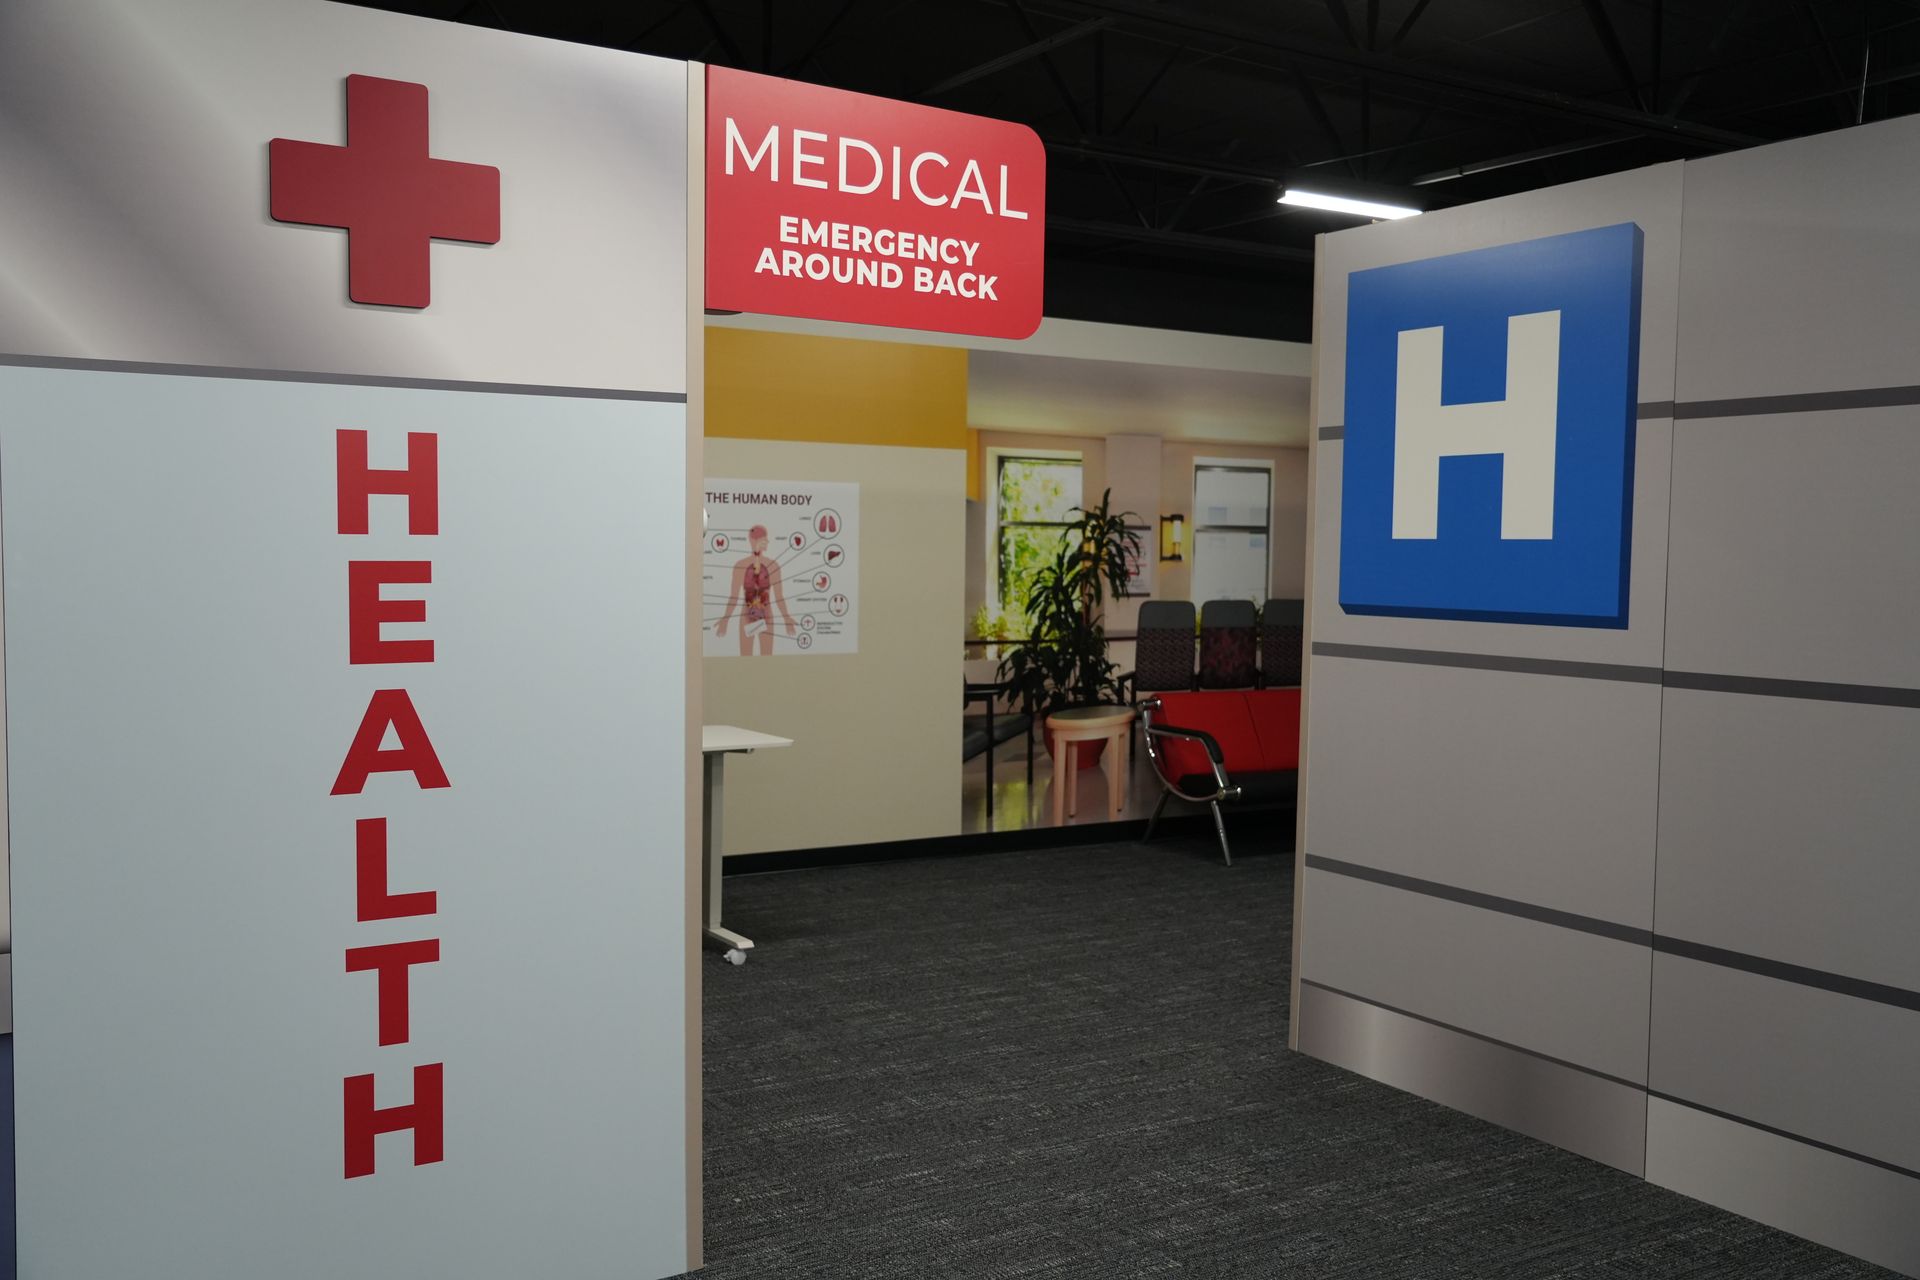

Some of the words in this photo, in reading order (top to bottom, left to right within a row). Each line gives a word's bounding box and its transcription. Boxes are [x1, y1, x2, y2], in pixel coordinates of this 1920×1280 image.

[725, 117, 1028, 220] MEDICAL
[754, 247, 903, 289] AROUND
[914, 266, 998, 301] BACK
[779, 215, 980, 266] EMERGENCY
[1391, 309, 1561, 540] H
[705, 492, 729, 504] THE
[732, 493, 778, 505] HUMAN
[781, 494, 812, 506] BODY
[329, 428, 451, 1179] HEALTH
